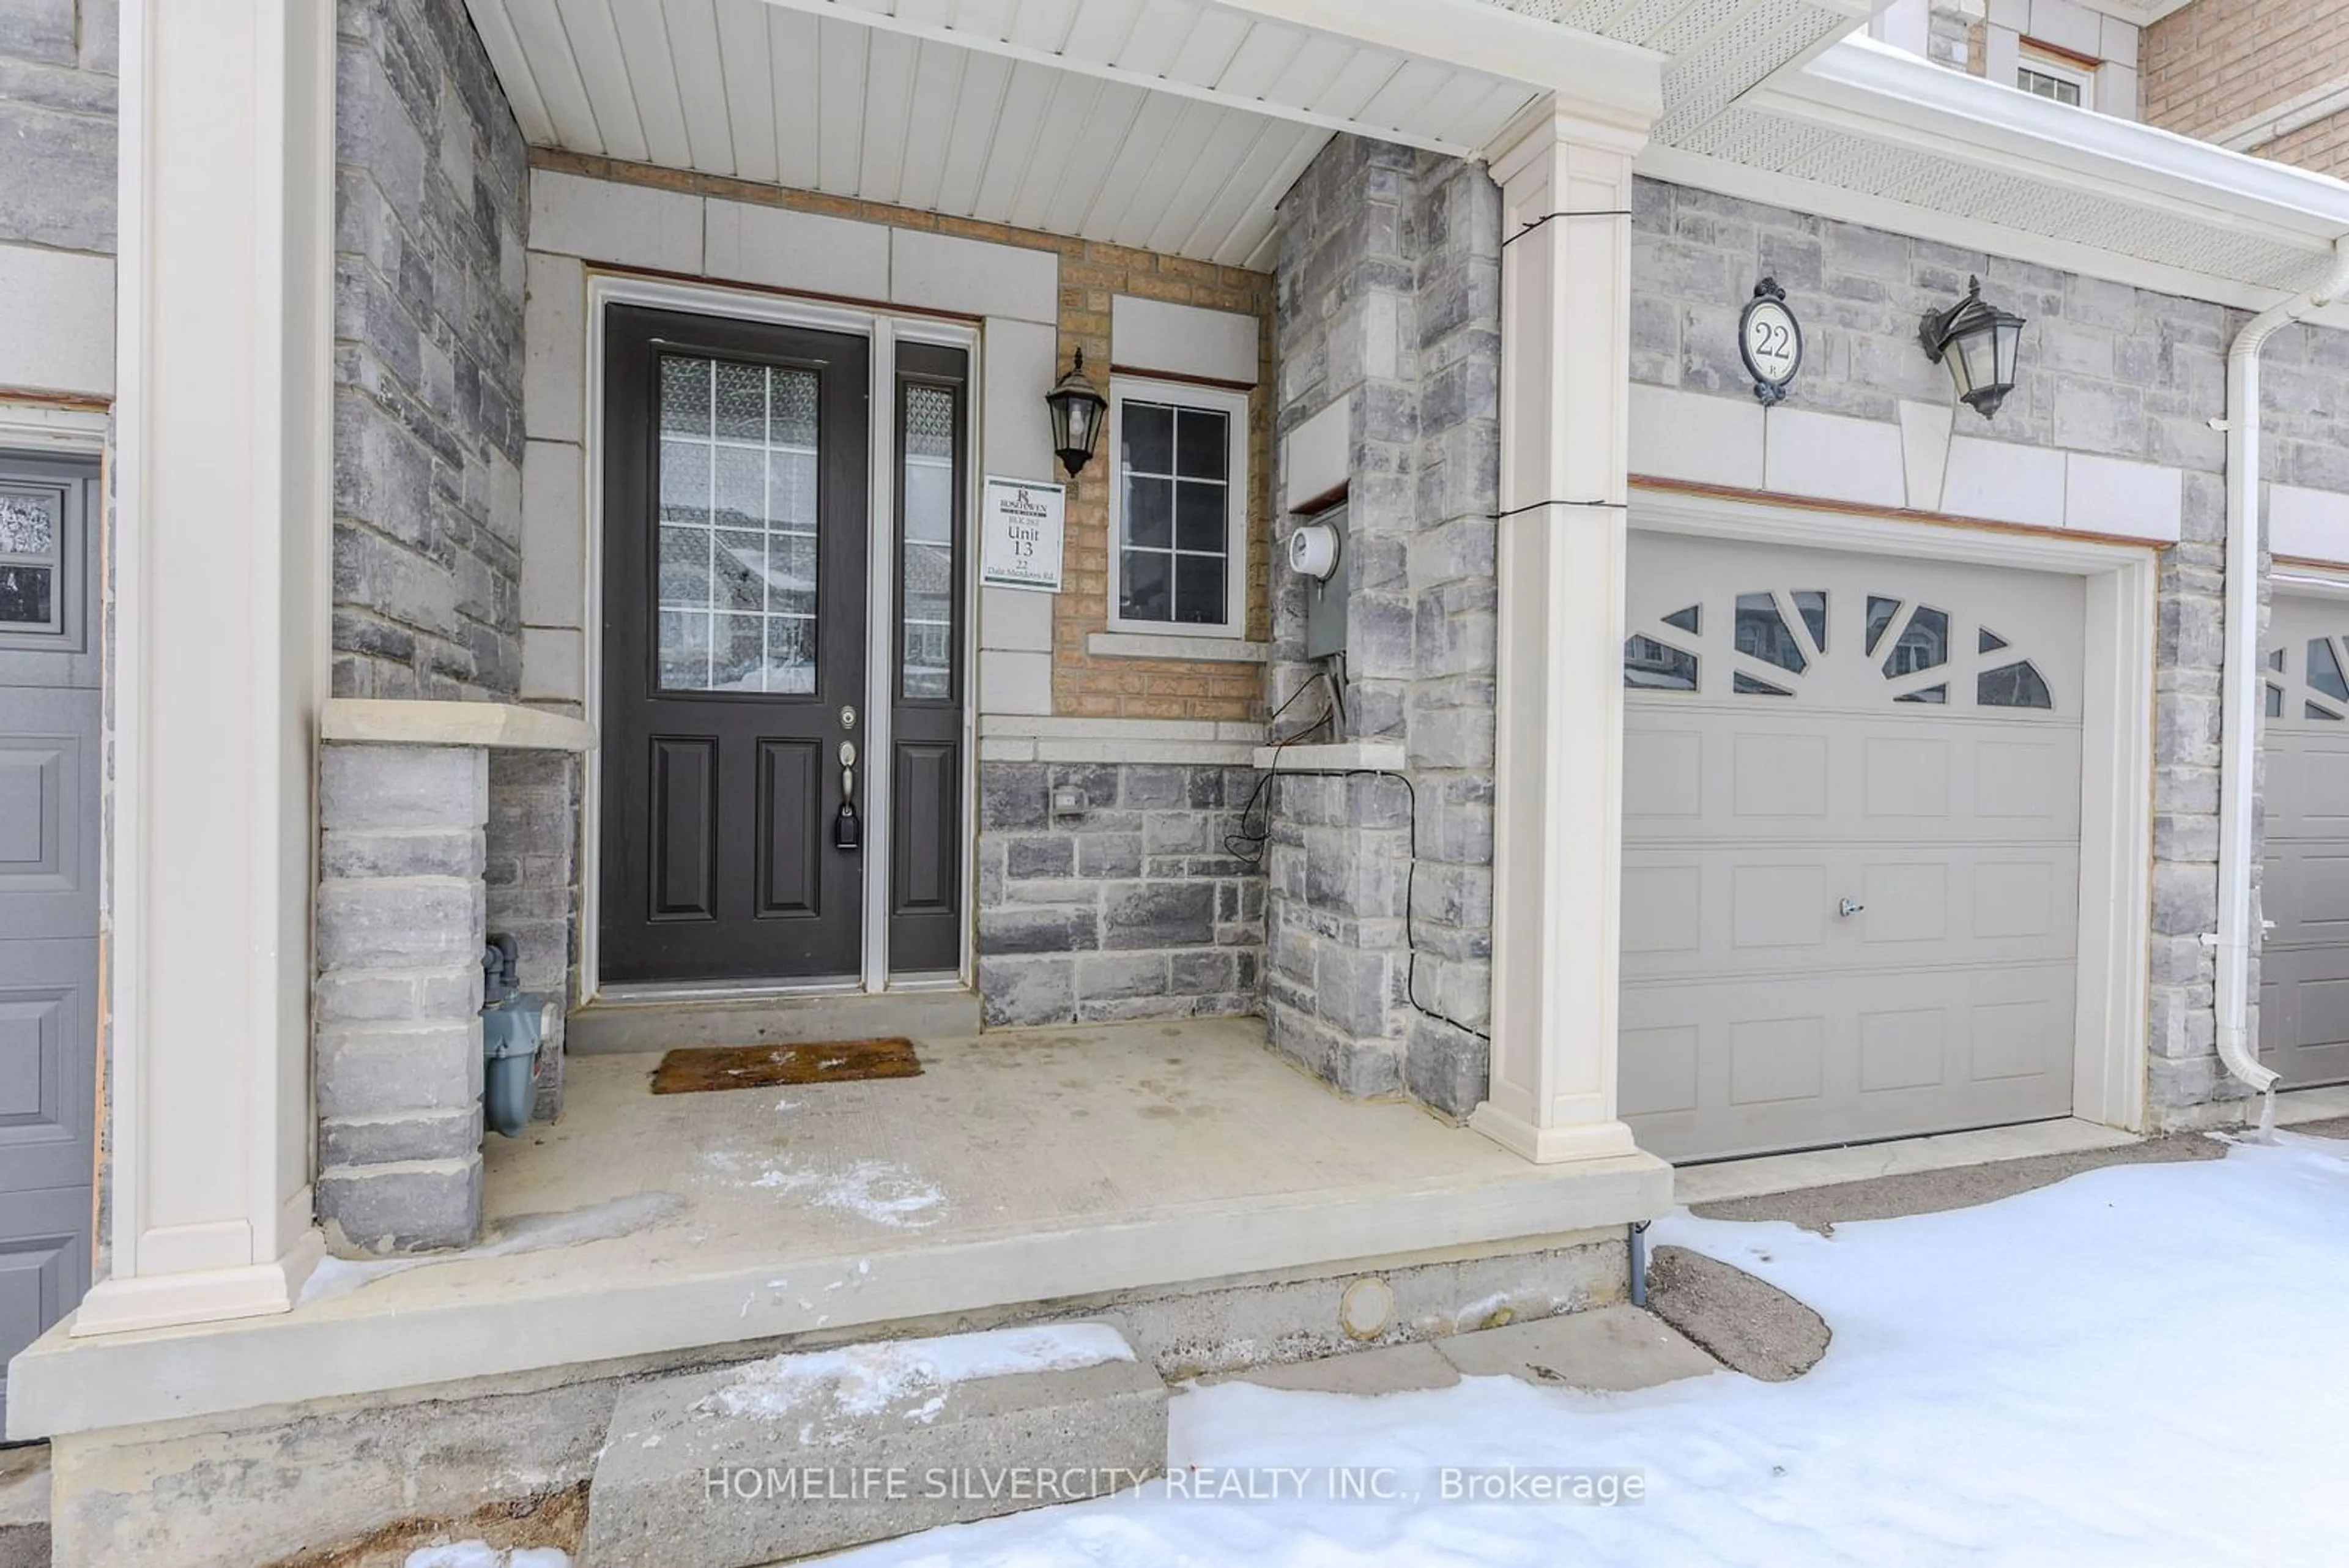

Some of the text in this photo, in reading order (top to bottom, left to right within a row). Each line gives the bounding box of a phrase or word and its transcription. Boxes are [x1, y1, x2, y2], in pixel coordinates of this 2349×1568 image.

[1756, 322, 1789, 360] 22
[1008, 526, 1039, 541] Unit
[1015, 541, 1033, 556] 13
[1017, 560, 1028, 569] 22
